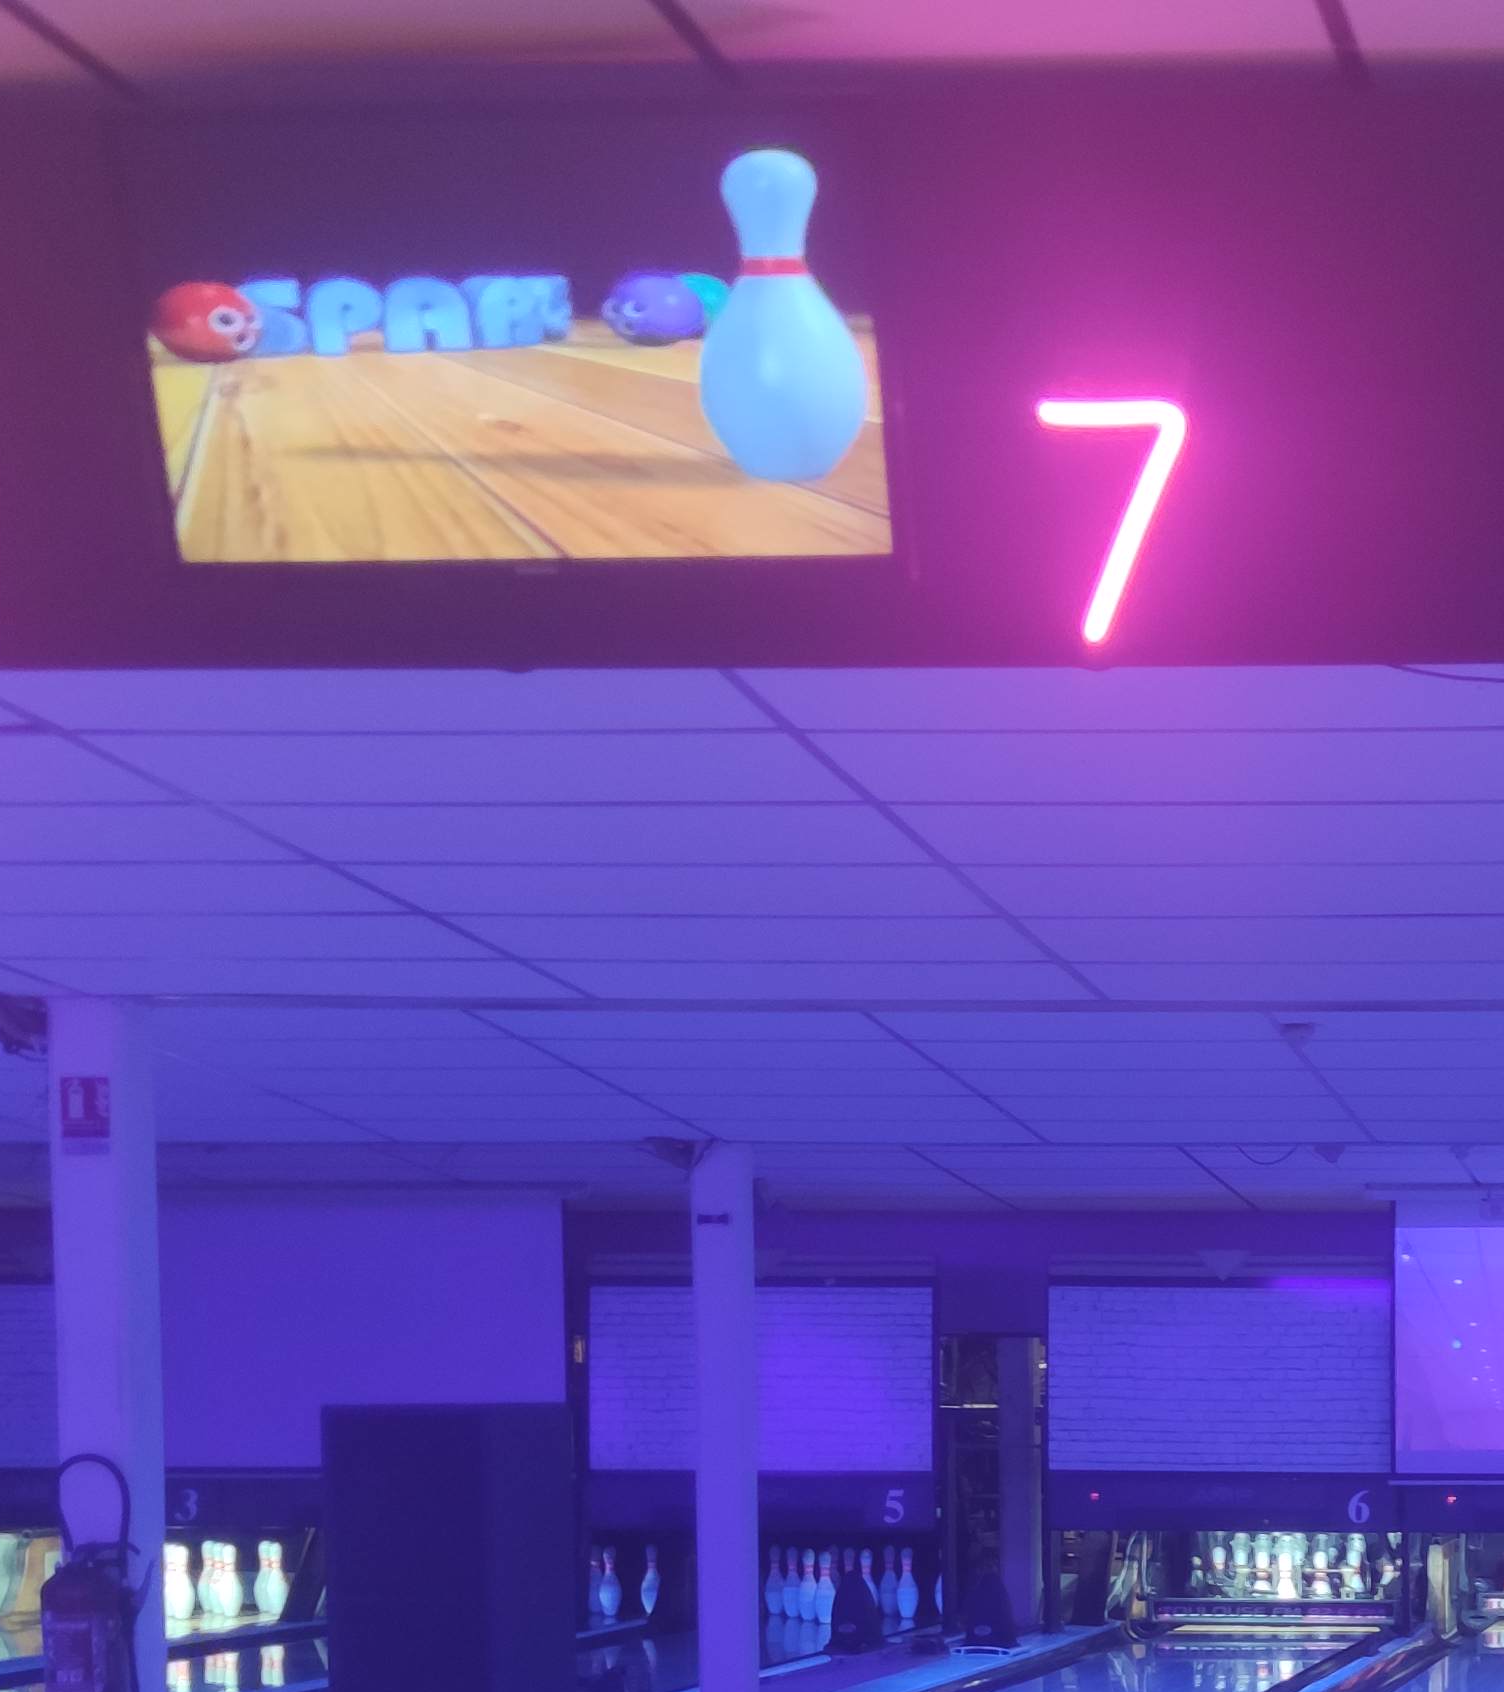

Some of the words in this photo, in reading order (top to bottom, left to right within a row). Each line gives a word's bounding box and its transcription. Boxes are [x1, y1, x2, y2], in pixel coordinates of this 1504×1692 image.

[1037, 399, 1187, 643] 7
[174, 1489, 199, 1522] 3
[882, 1489, 905, 1524] 5
[1347, 1489, 1371, 1524] 6
